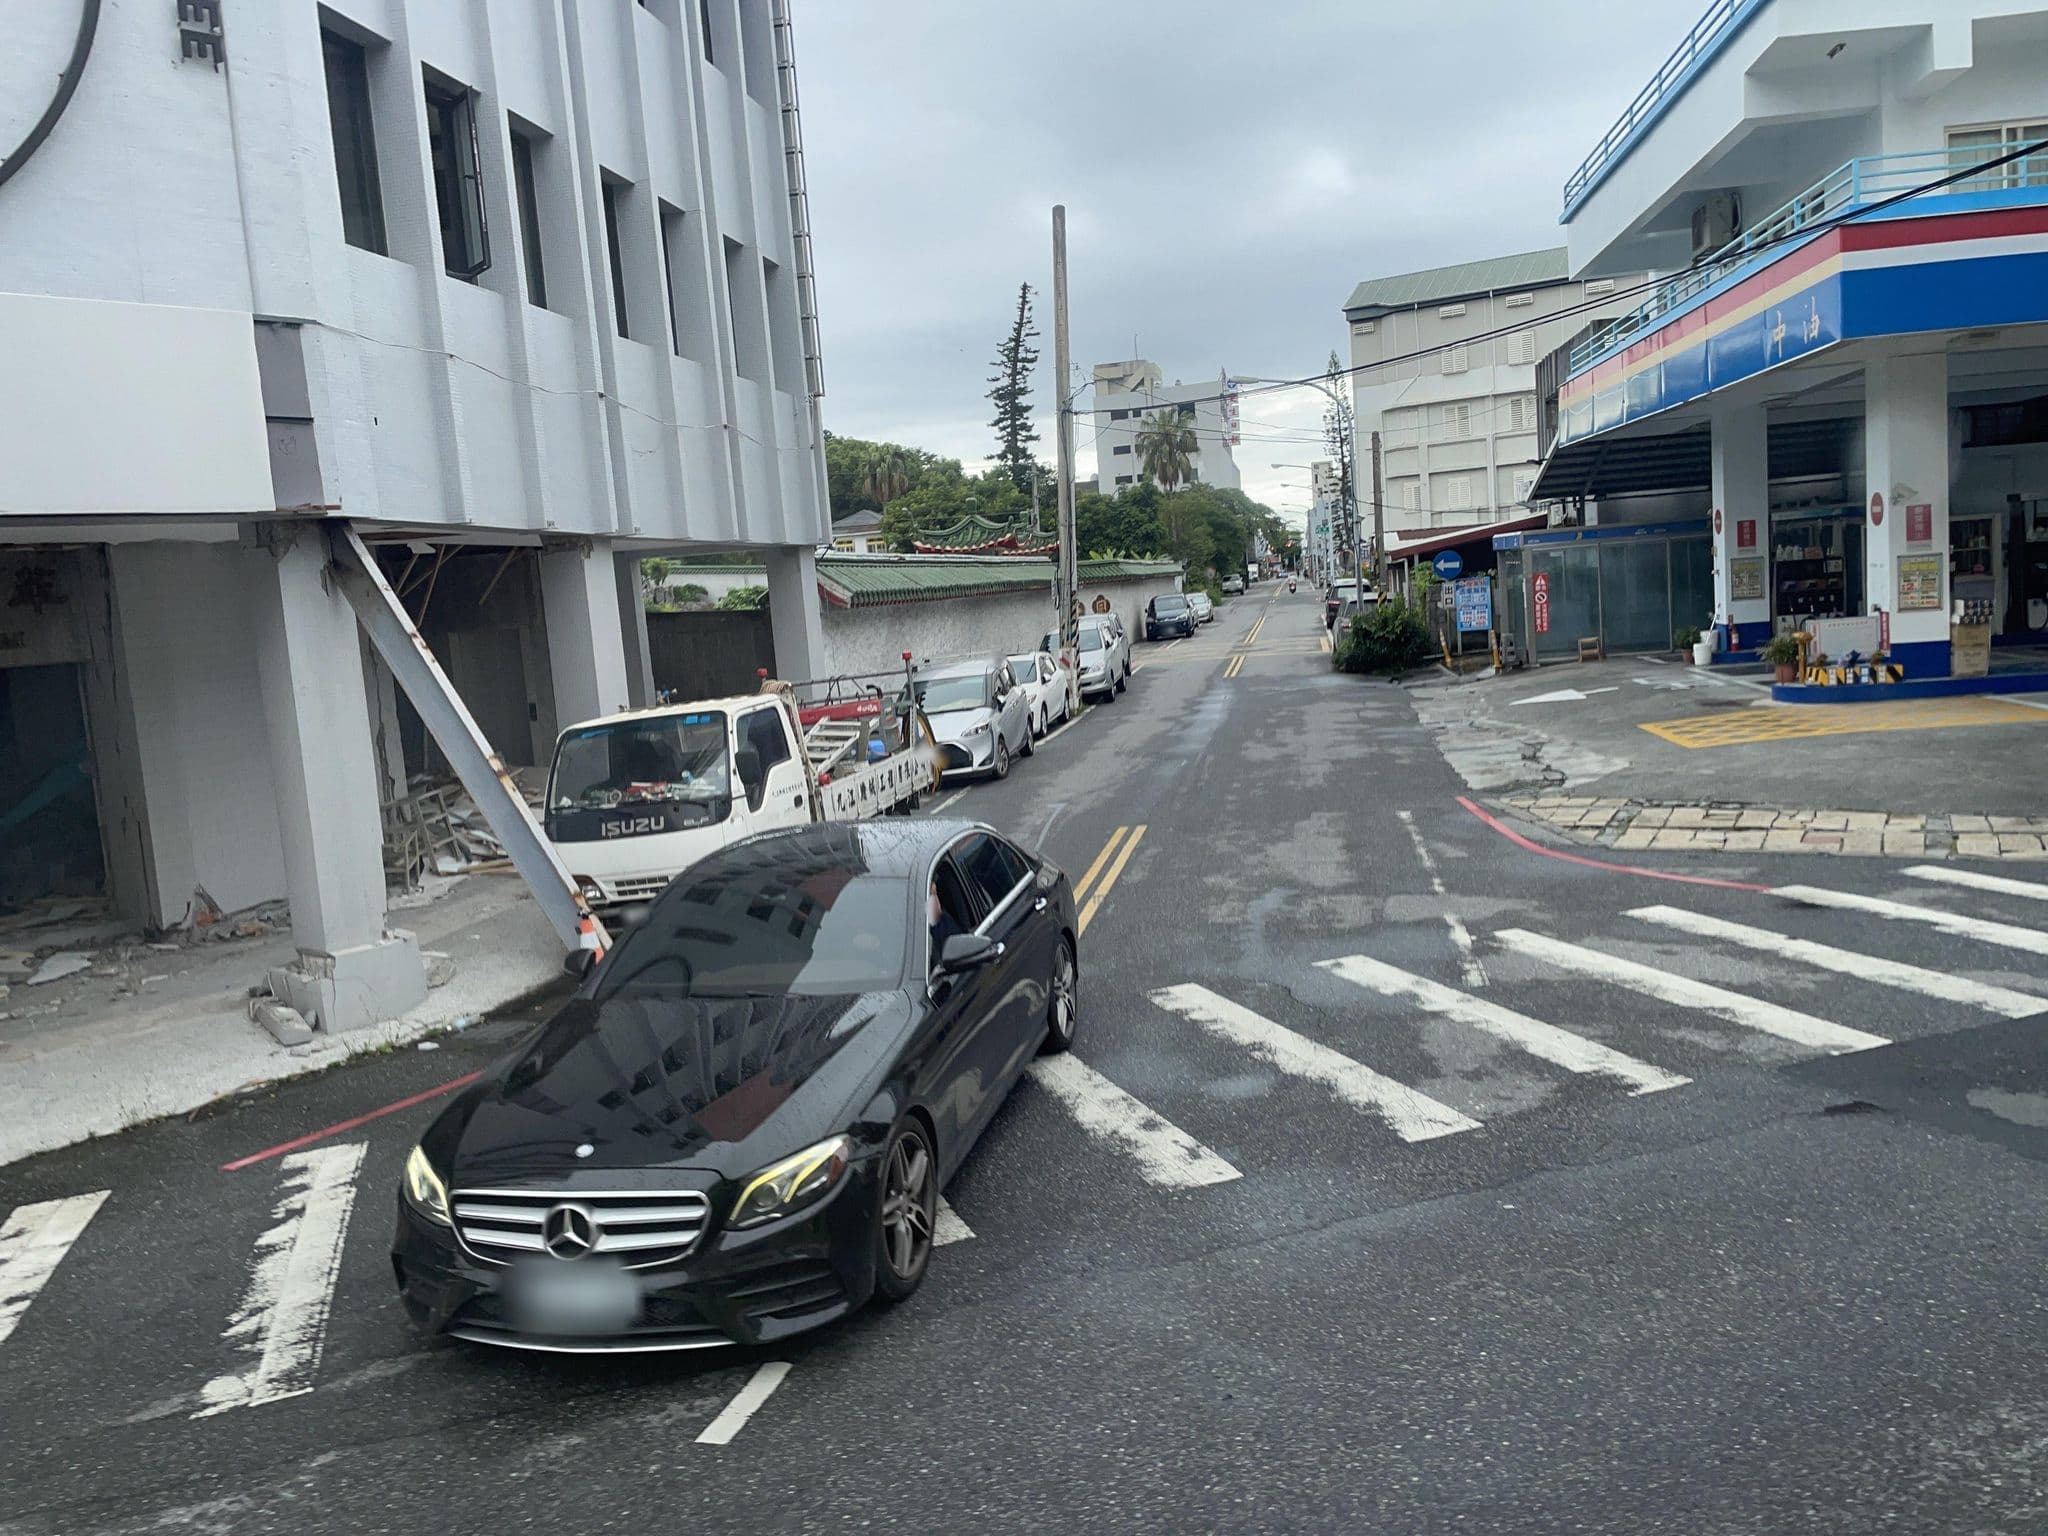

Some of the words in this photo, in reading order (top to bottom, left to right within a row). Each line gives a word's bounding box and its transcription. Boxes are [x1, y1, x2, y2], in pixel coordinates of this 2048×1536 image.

[1773, 296, 1820, 359] 中油
[1444, 585, 1453, 605] 出口
[601, 815, 665, 837] ISUZU
